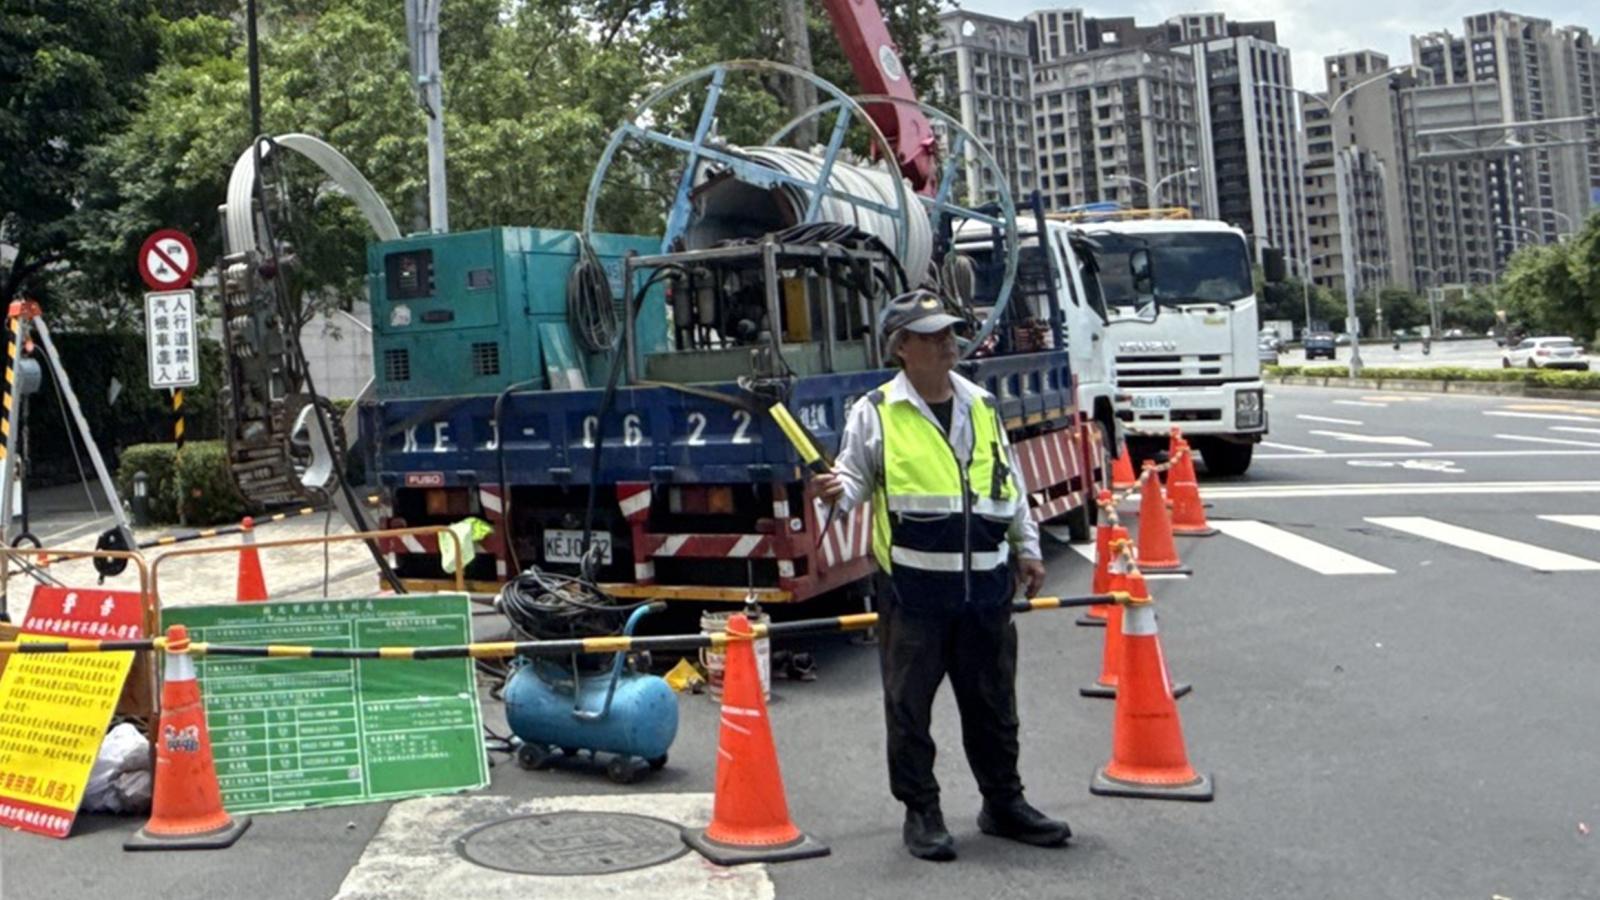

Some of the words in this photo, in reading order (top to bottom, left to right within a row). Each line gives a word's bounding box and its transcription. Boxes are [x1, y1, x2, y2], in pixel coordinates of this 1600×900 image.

[154, 299, 171, 381] 汽機車進入
[173, 297, 190, 380] 人行道禁止
[408, 474, 441, 484] FUSO
